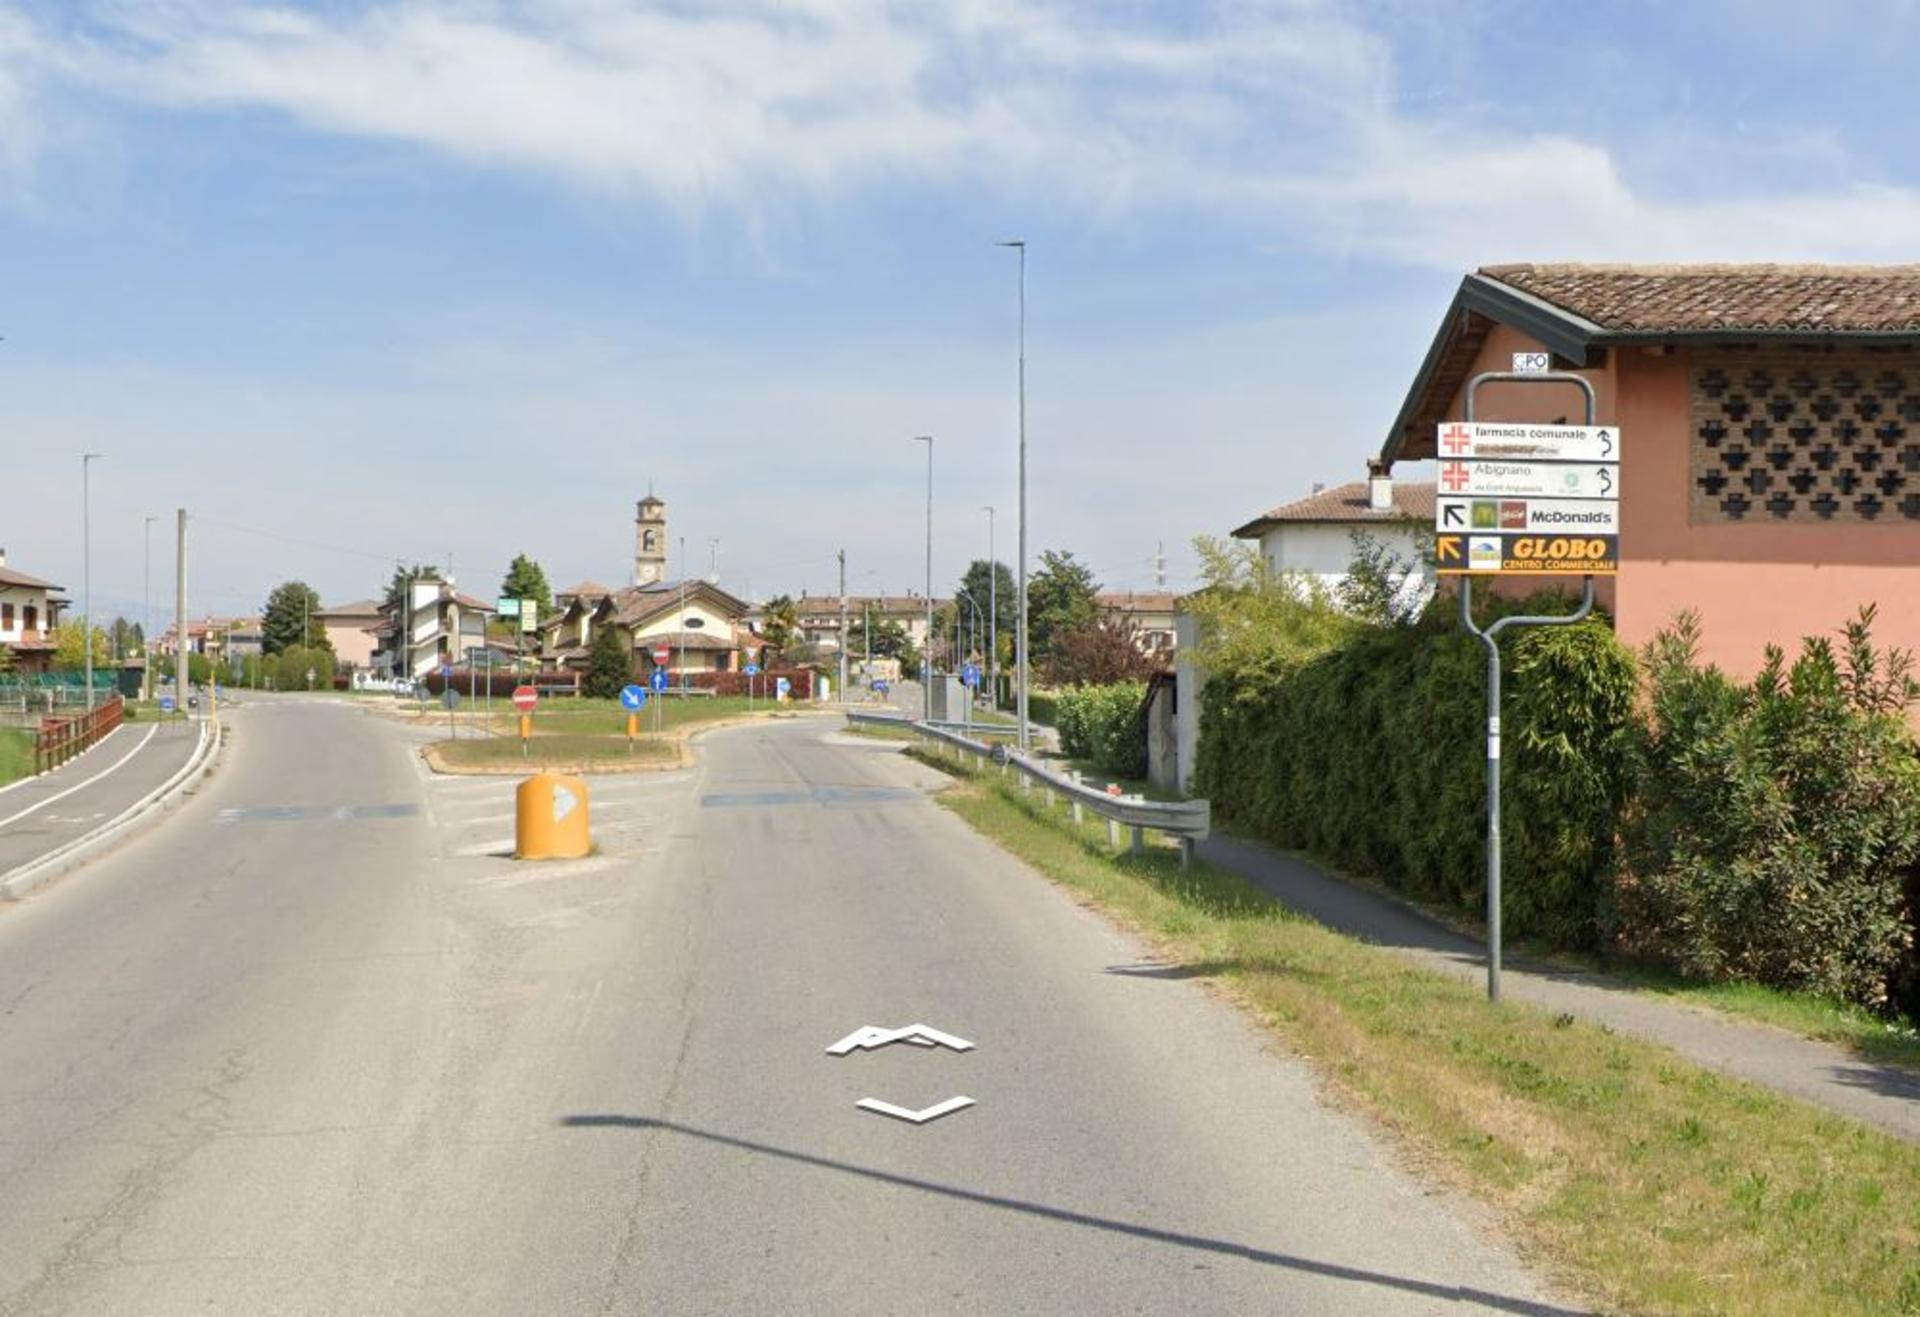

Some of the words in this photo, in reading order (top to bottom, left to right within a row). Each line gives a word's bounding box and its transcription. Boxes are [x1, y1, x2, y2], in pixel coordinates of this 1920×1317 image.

[1475, 427, 1526, 438] farmacia
[1529, 428, 1587, 440] comunale
[1531, 510, 1612, 524] McDonald's
[1513, 538, 1607, 560] GLOBO
[1503, 559, 1543, 570] CENTRO
[1545, 560, 1615, 570] COMMERCIALE
